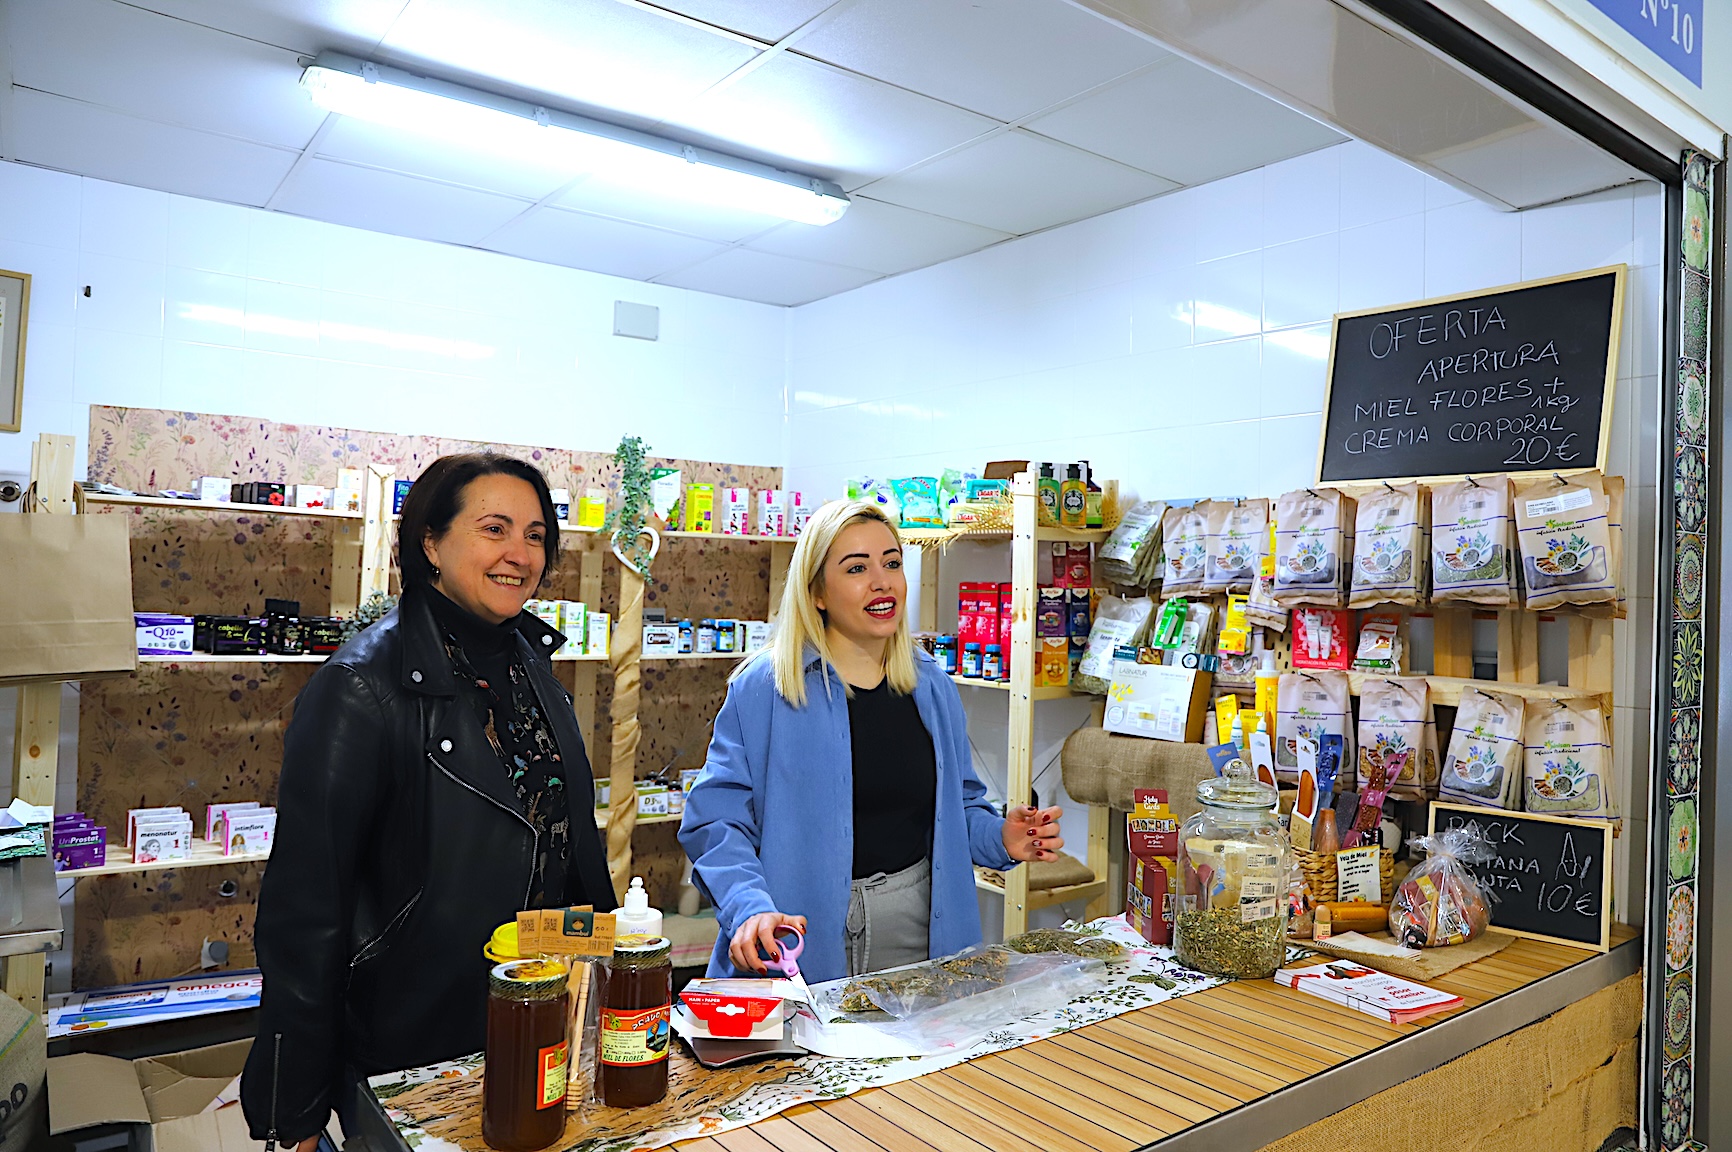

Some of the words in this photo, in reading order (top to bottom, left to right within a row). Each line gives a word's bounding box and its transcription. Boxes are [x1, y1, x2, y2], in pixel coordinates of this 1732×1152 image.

[1369, 306, 1506, 359] OFERTA
[1417, 340, 1559, 384] APERTURA
[1354, 398, 1417, 423] MIEL
[1430, 378, 1532, 411] FLORES
[1344, 427, 1429, 455] CREMA
[1448, 414, 1564, 442] CORPORAL
[1119, 667, 1148, 676] LABNATUR
[622, 1054, 644, 1062] FLORES
